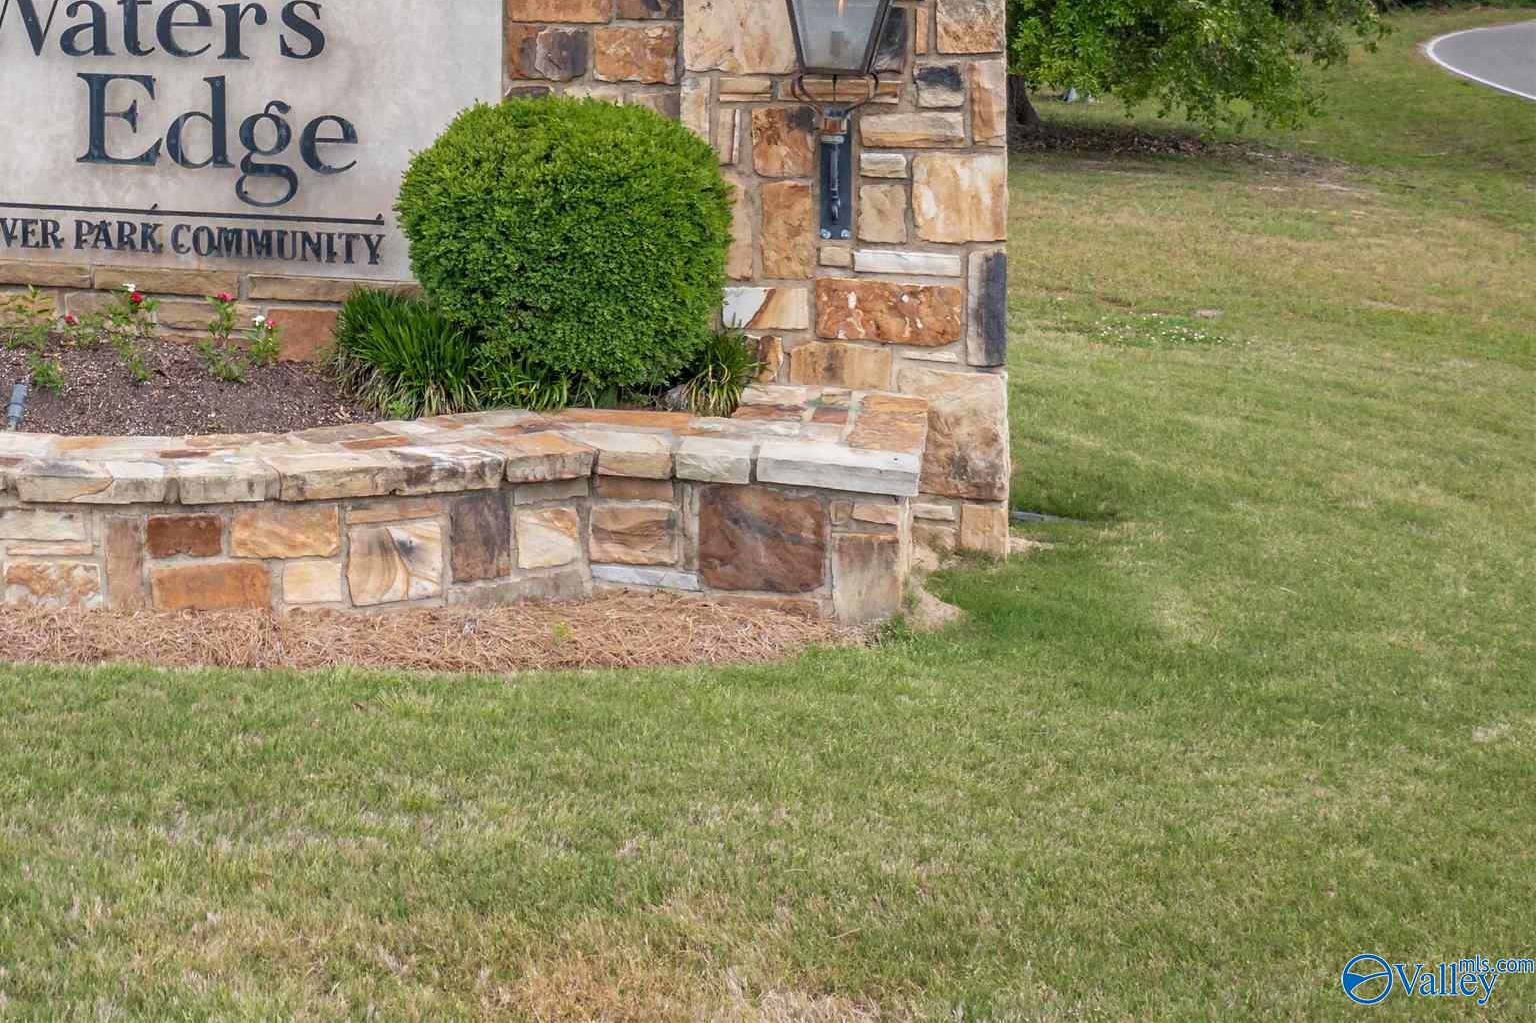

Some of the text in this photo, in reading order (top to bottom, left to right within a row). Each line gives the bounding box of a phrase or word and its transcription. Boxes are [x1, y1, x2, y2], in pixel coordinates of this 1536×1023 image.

[76, 72, 358, 207] Edge
[73, 219, 164, 254] PARK
[170, 223, 385, 265] COMMUNITY
